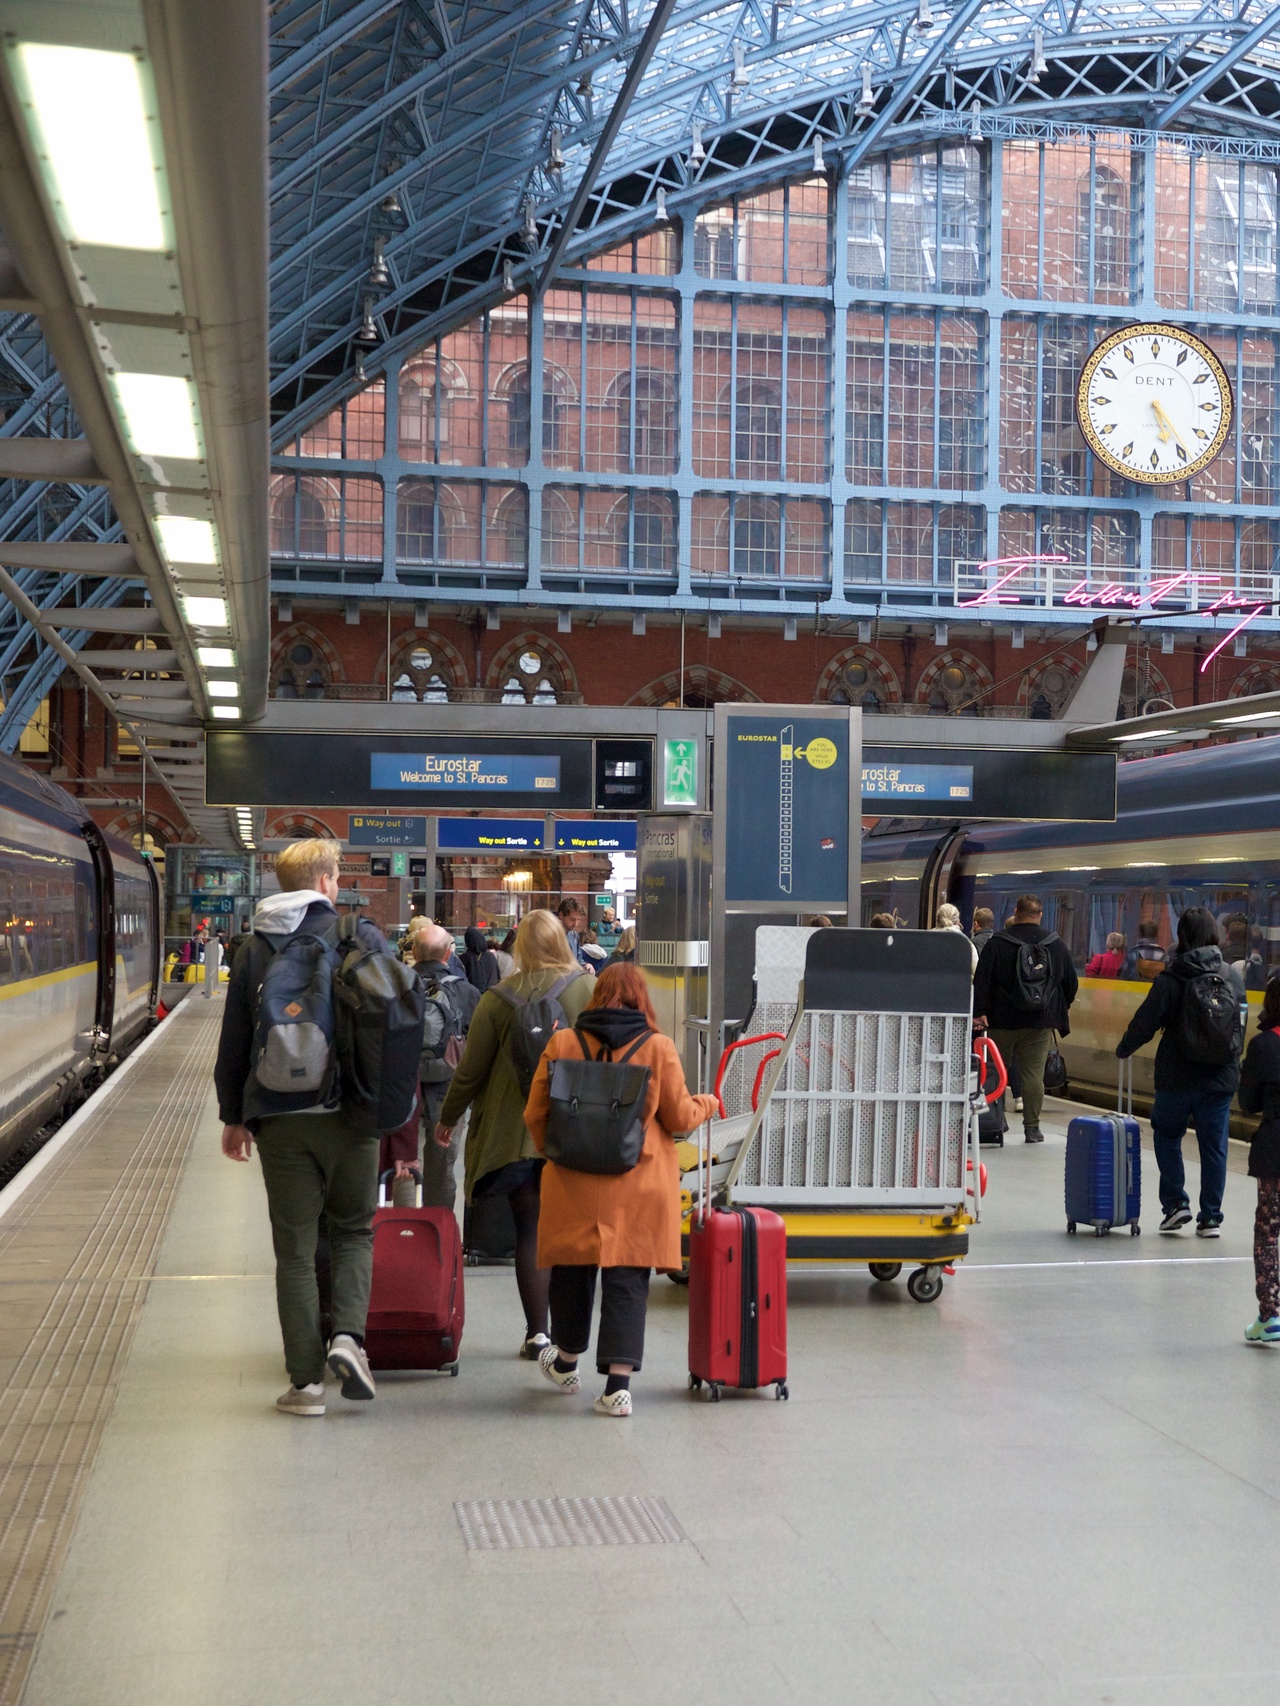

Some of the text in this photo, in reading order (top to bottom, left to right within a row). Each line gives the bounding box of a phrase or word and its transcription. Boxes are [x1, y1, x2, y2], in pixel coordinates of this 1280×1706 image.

[1135, 375, 1175, 386] DENT
[738, 734, 778, 742] EUROSTAR
[425, 755, 482, 772] Eurostar
[400, 771, 441, 783] Welcome
[444, 772, 454, 783] to
[471, 772, 508, 784] Pancras
[866, 781, 876, 791] to
[891, 781, 925, 793] Pancras
[366, 819, 385, 829] Way
[375, 835, 402, 843] Sortie
[478, 836, 494, 846] Way
[506, 836, 528, 845] Sortie
[571, 838, 587, 847] Way
[598, 838, 620, 846] Sortie
